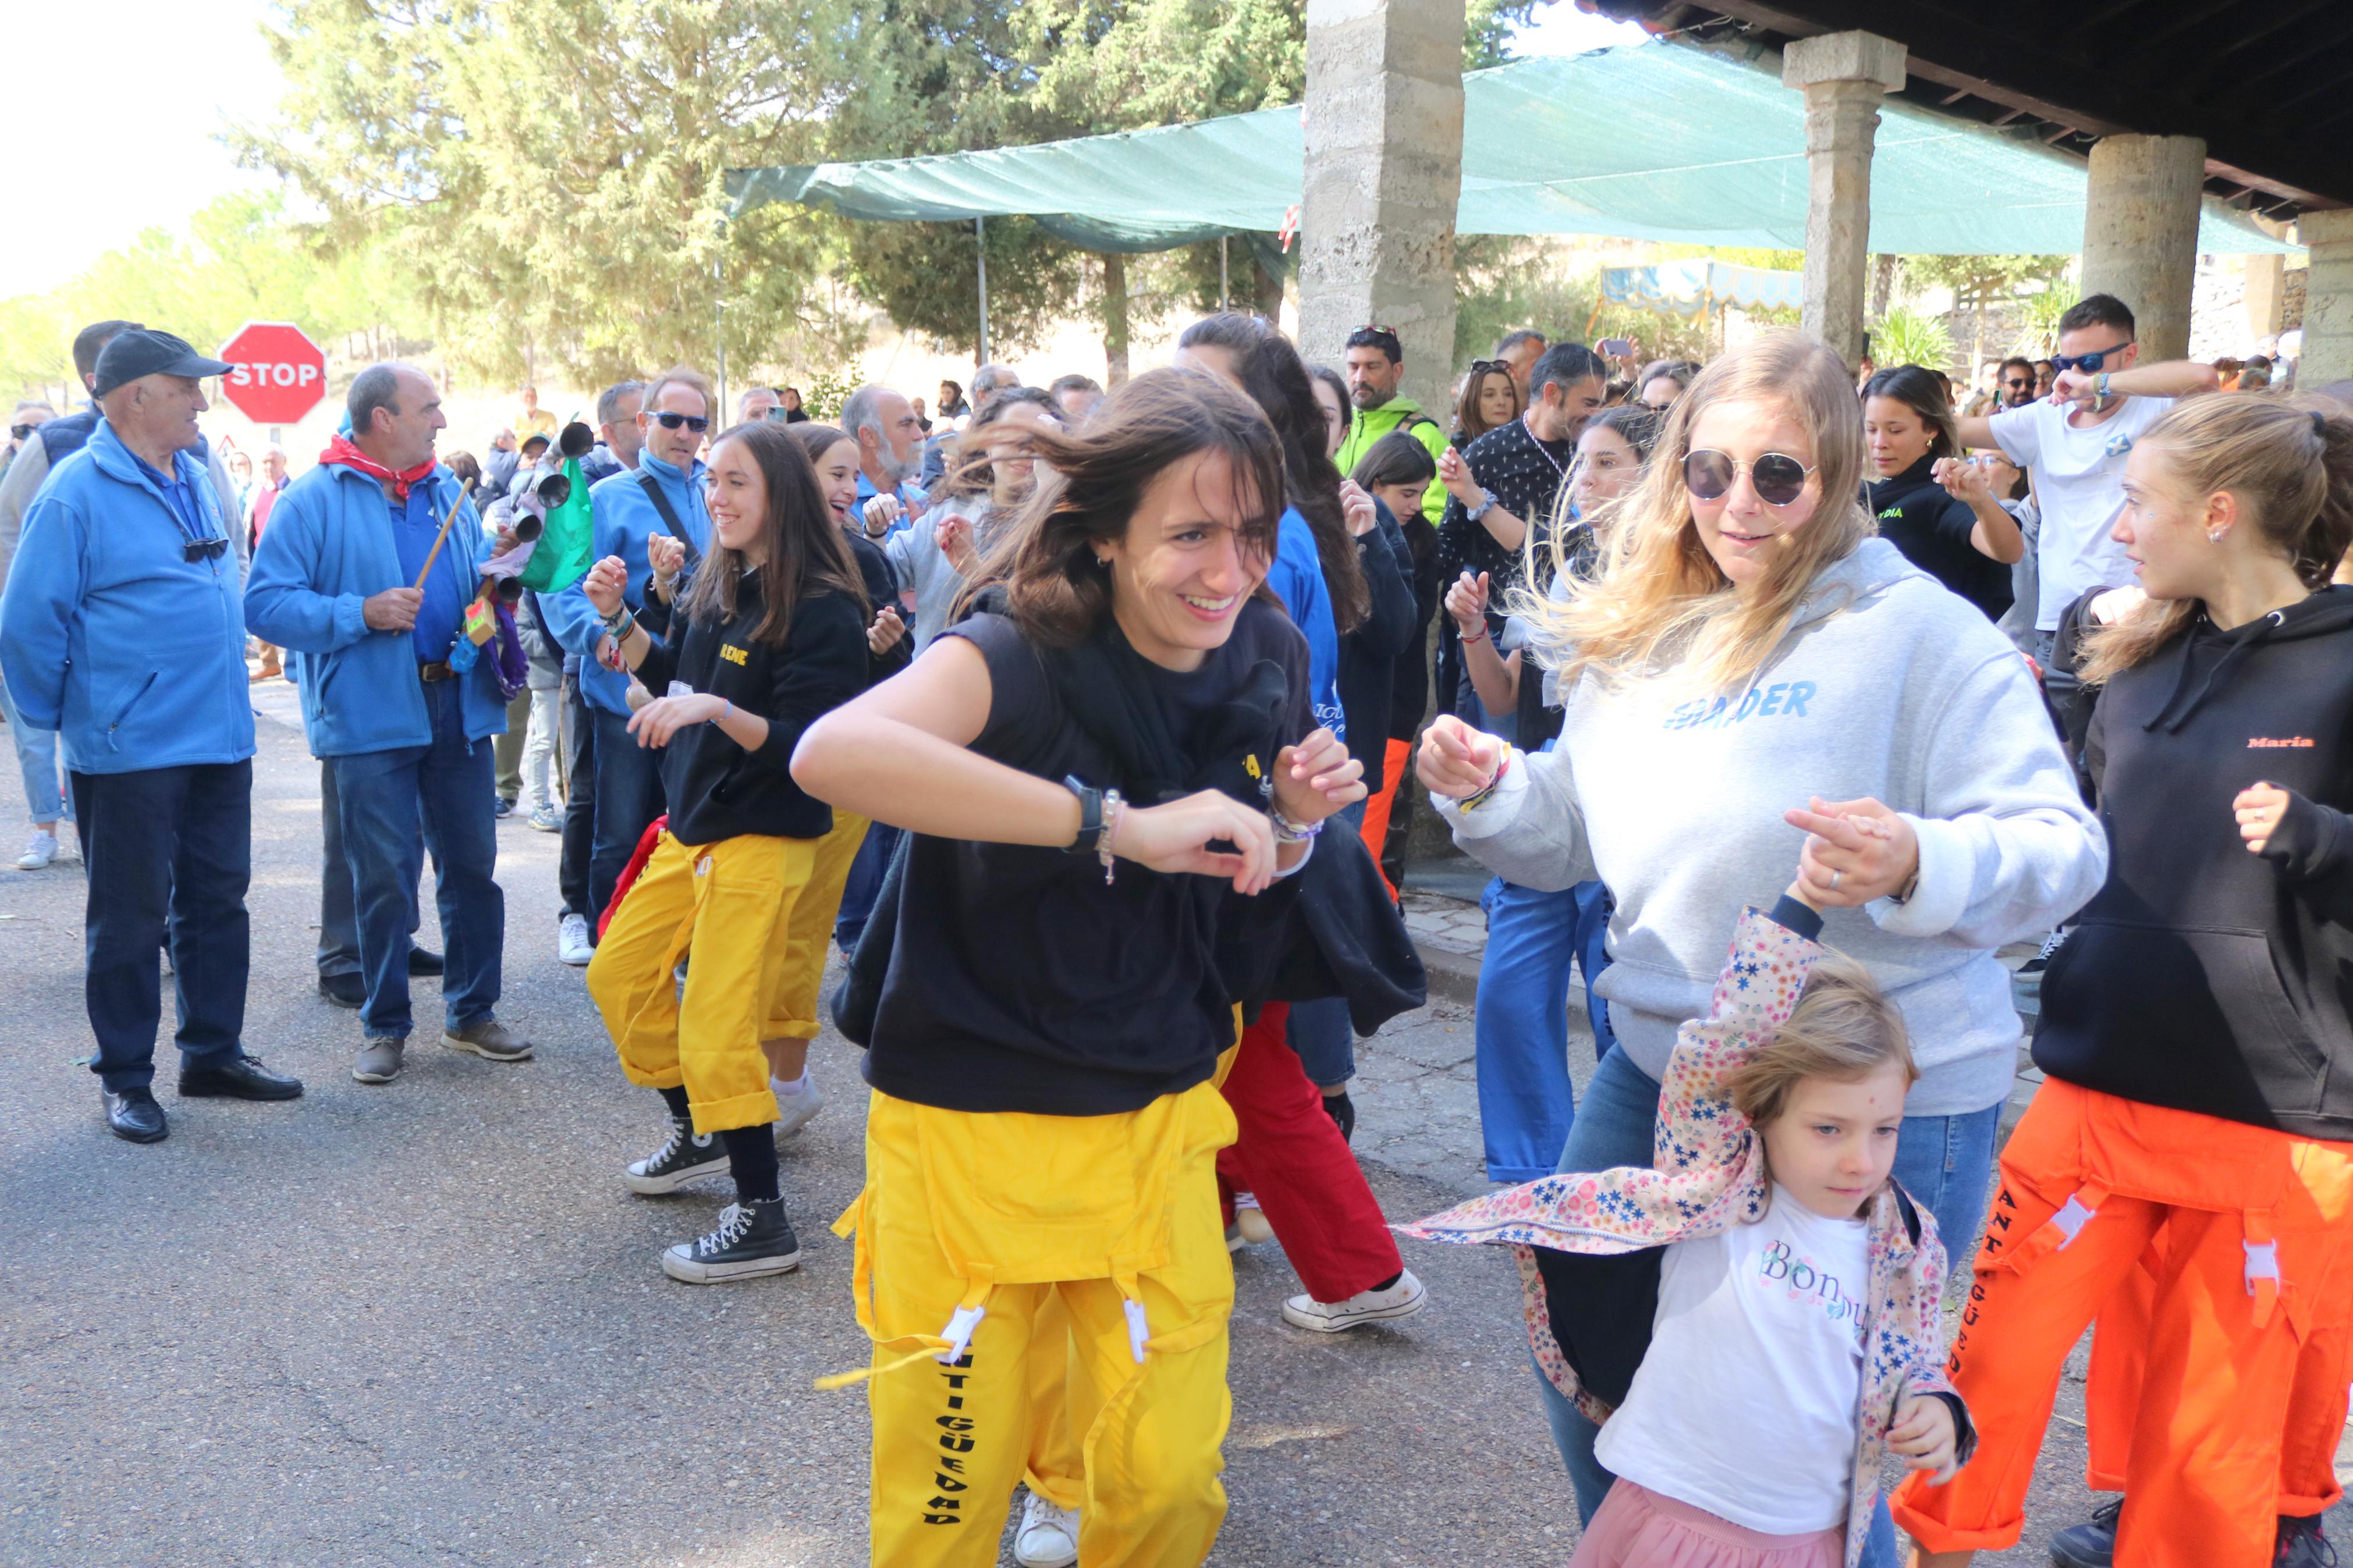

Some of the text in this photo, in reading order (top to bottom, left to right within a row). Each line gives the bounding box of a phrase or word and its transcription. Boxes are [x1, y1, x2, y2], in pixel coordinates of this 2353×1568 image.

[230, 362, 318, 387] STOP
[1947, 1190, 2018, 1382] ANTGÜED
[921, 1338, 976, 1525] NTIGÜEDAD
